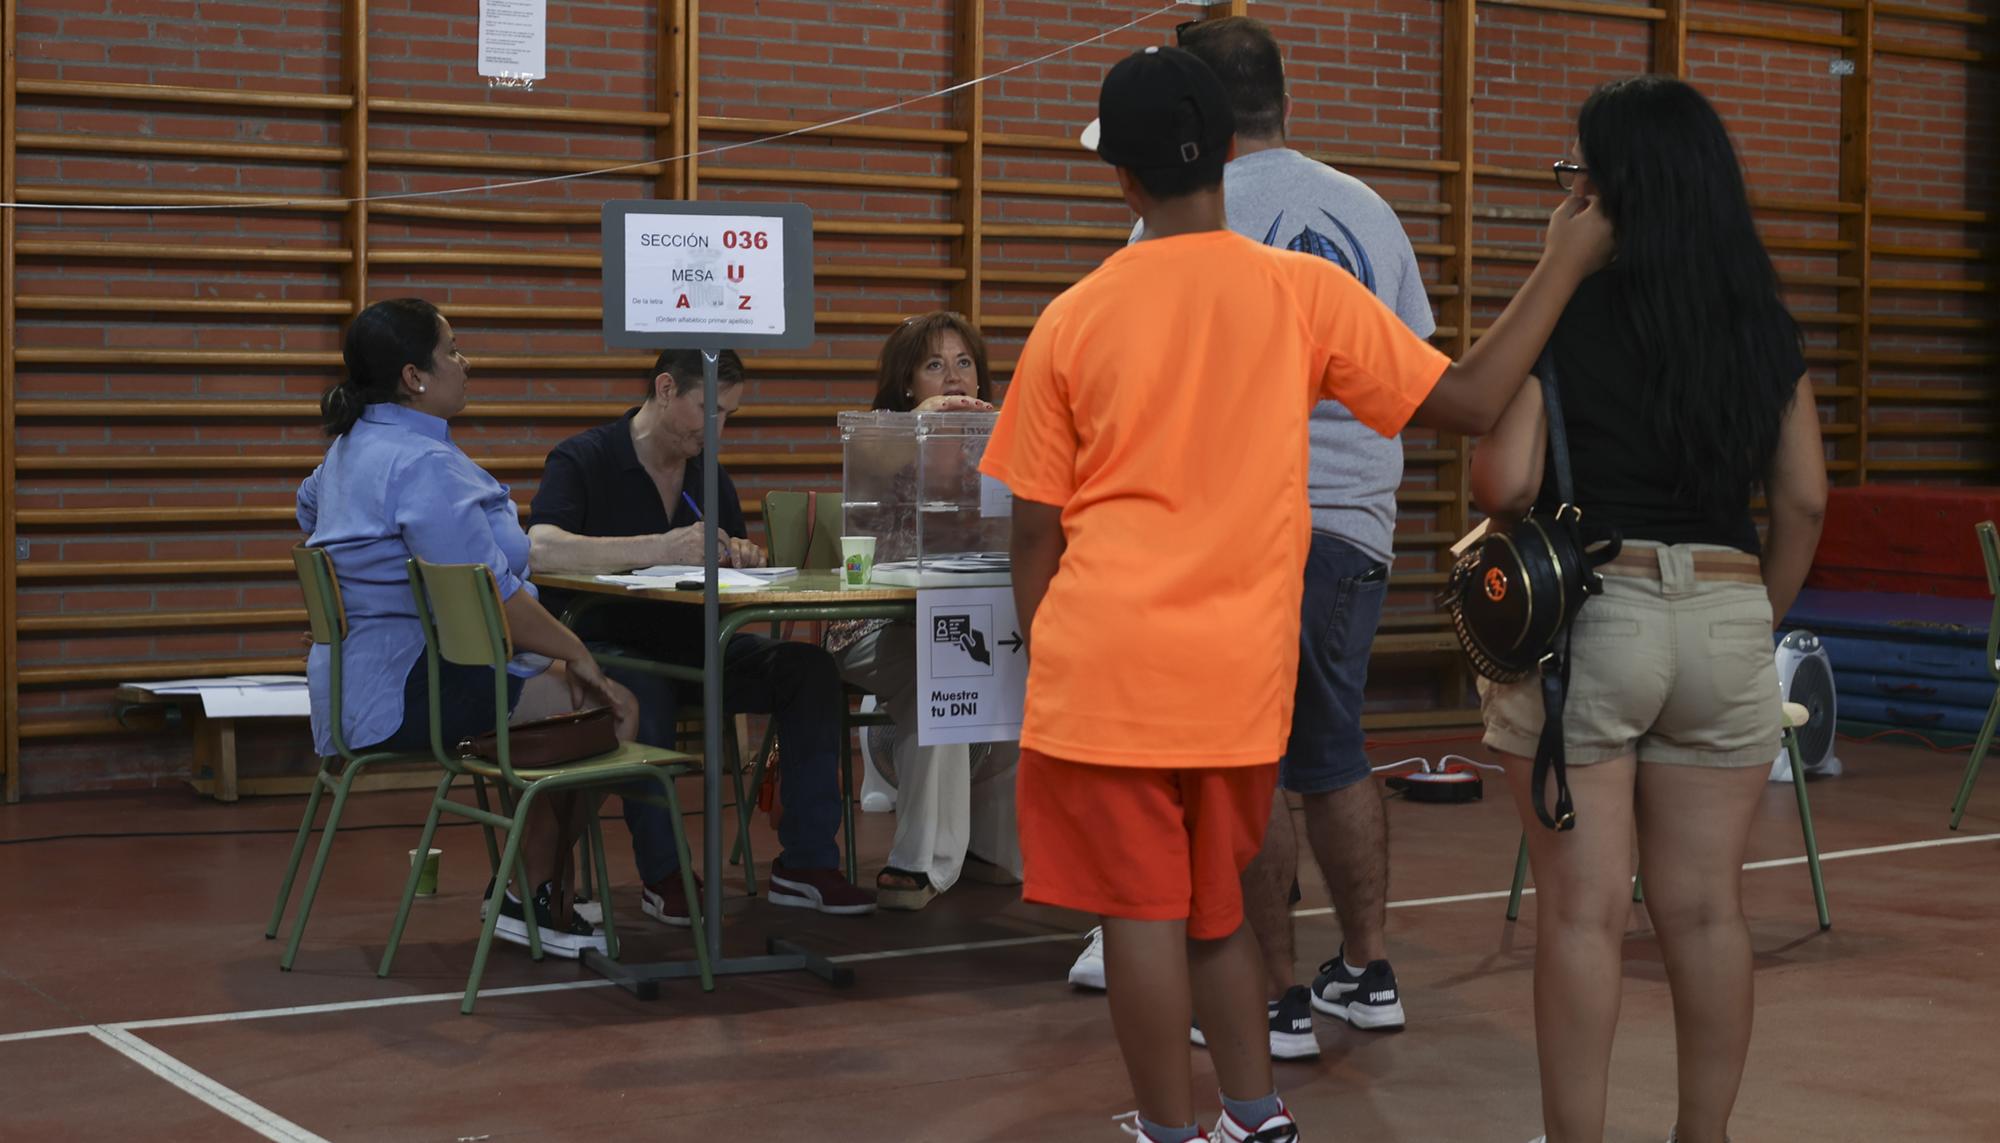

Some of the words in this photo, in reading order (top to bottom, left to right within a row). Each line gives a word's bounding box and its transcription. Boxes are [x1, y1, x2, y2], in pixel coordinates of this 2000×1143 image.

[641, 232, 709, 248] SECCIÓN
[722, 230, 768, 250] 036
[672, 269, 714, 282] MESA
[727, 264, 744, 283] U
[632, 297, 641, 305] De
[649, 297, 663, 305] letra
[675, 294, 691, 309] A
[738, 295, 752, 310] Z
[655, 316, 676, 325] (Orden
[708, 317, 727, 326] primer
[931, 691, 979, 702] Muestra
[931, 705, 945, 717] tu
[951, 702, 977, 716] DNI
[1369, 989, 1395, 1003] PUMA
[1292, 1017, 1312, 1030] PUM
